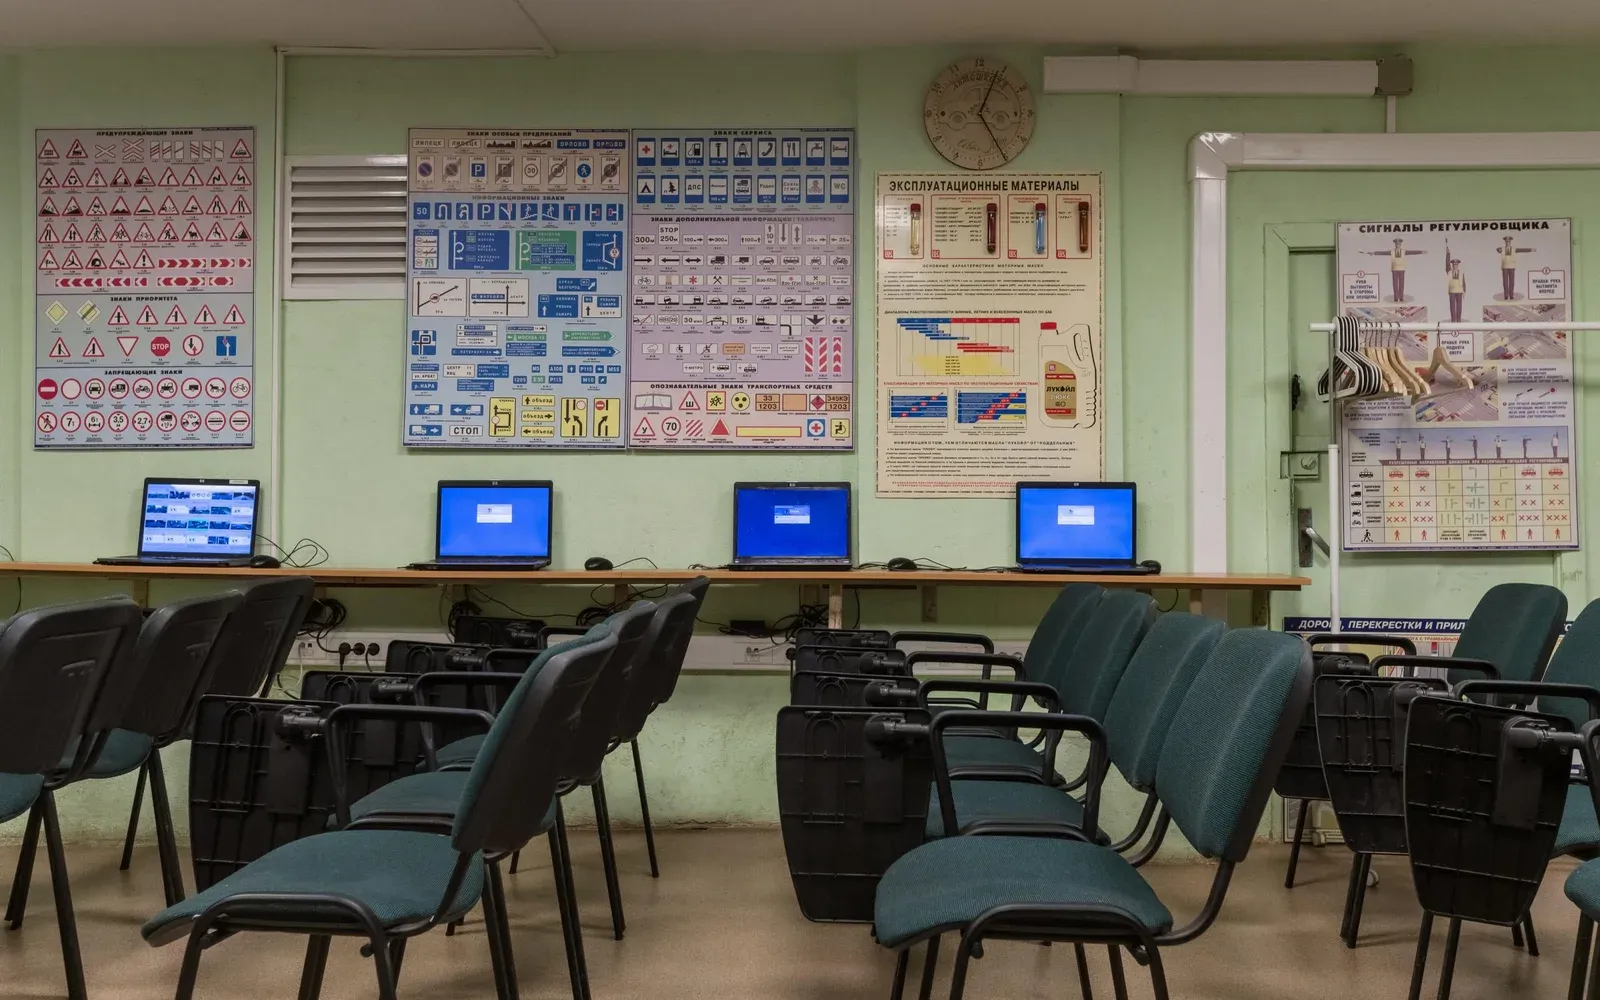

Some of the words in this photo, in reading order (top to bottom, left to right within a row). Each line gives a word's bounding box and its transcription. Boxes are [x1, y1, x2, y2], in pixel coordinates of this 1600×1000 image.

[976, 58, 984, 66] 12
[890, 180, 1008, 193] ЭКСПЛУАТАЦИОННЫЕ
[1011, 181, 1079, 191] МАТЕРИАЛЫ
[1359, 224, 1423, 233] СИГНАЛЫ
[1430, 221, 1550, 232] РЕГУЛИРОВЩИКА
[666, 422, 677, 430] 70
[1348, 620, 1422, 629] ПЕРЕКРЕСТКИ
